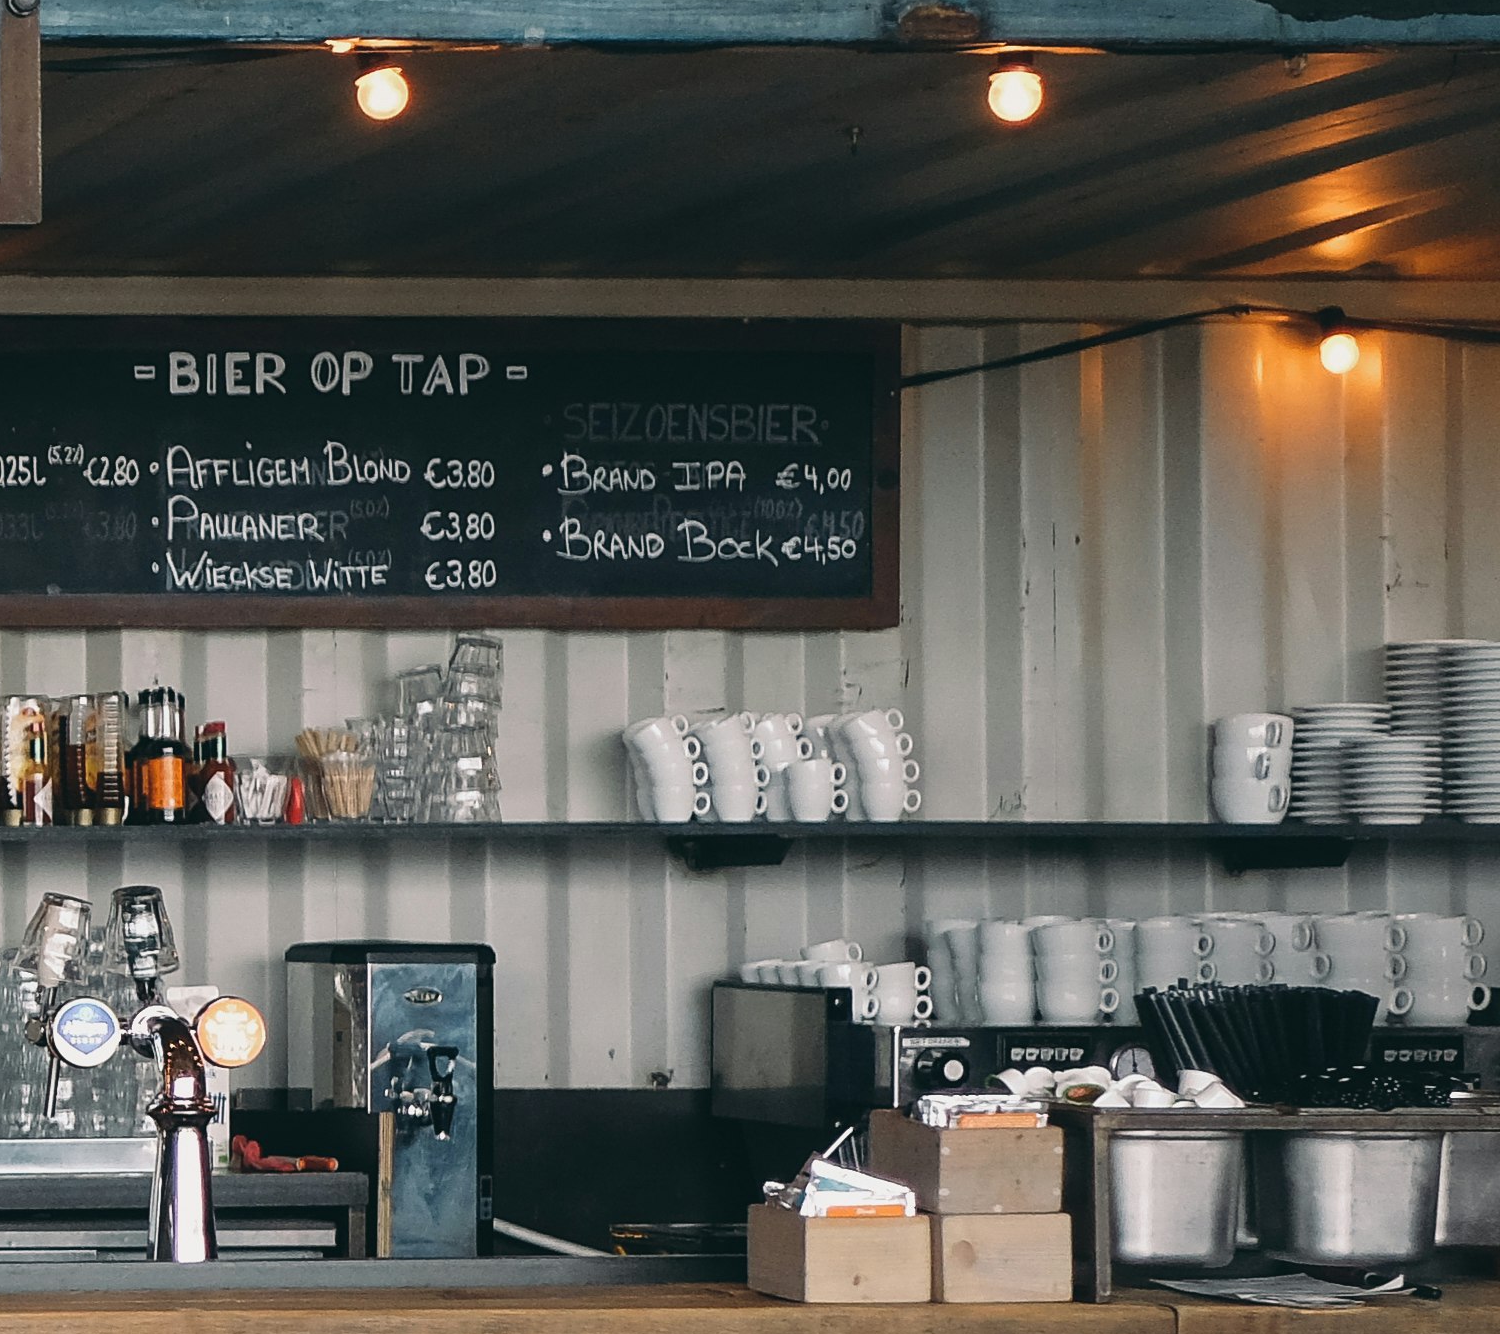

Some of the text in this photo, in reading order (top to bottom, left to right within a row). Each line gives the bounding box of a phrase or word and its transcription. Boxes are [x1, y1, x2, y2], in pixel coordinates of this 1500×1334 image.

[168, 350, 492, 397] BIER OP TAP
[322, 439, 413, 488] BLOND
[557, 450, 657, 496] BRAND
[166, 493, 326, 543] PAULANER
[556, 516, 665, 561] BRAND
